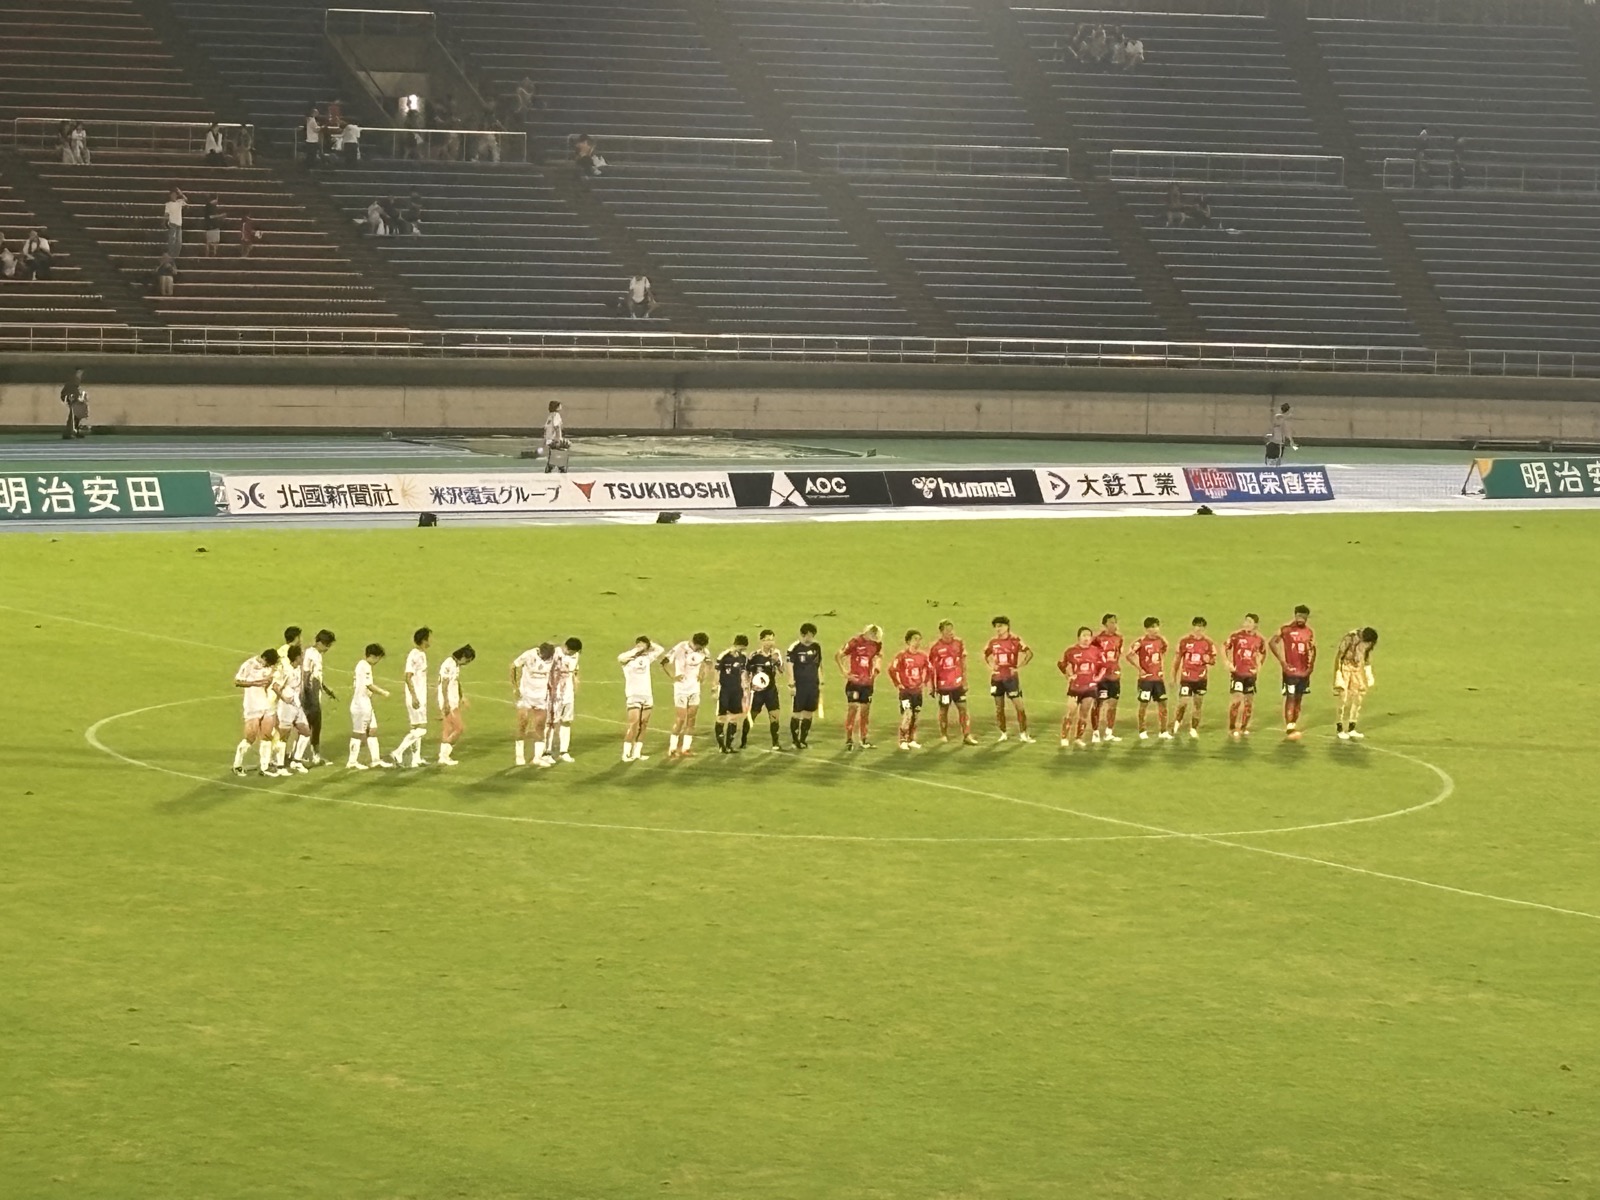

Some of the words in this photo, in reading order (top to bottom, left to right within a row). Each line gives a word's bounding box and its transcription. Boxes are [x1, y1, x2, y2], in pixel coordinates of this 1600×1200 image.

[603, 481, 730, 500] TSUKIBOSHI
[805, 477, 847, 494] AOC
[937, 477, 1016, 497] hummel
[1077, 472, 1180, 497] 大鉄工業
[1235, 471, 1328, 494] 昭栄産業
[0, 476, 165, 514] 明治安田
[276, 483, 400, 509] 北國新聞社
